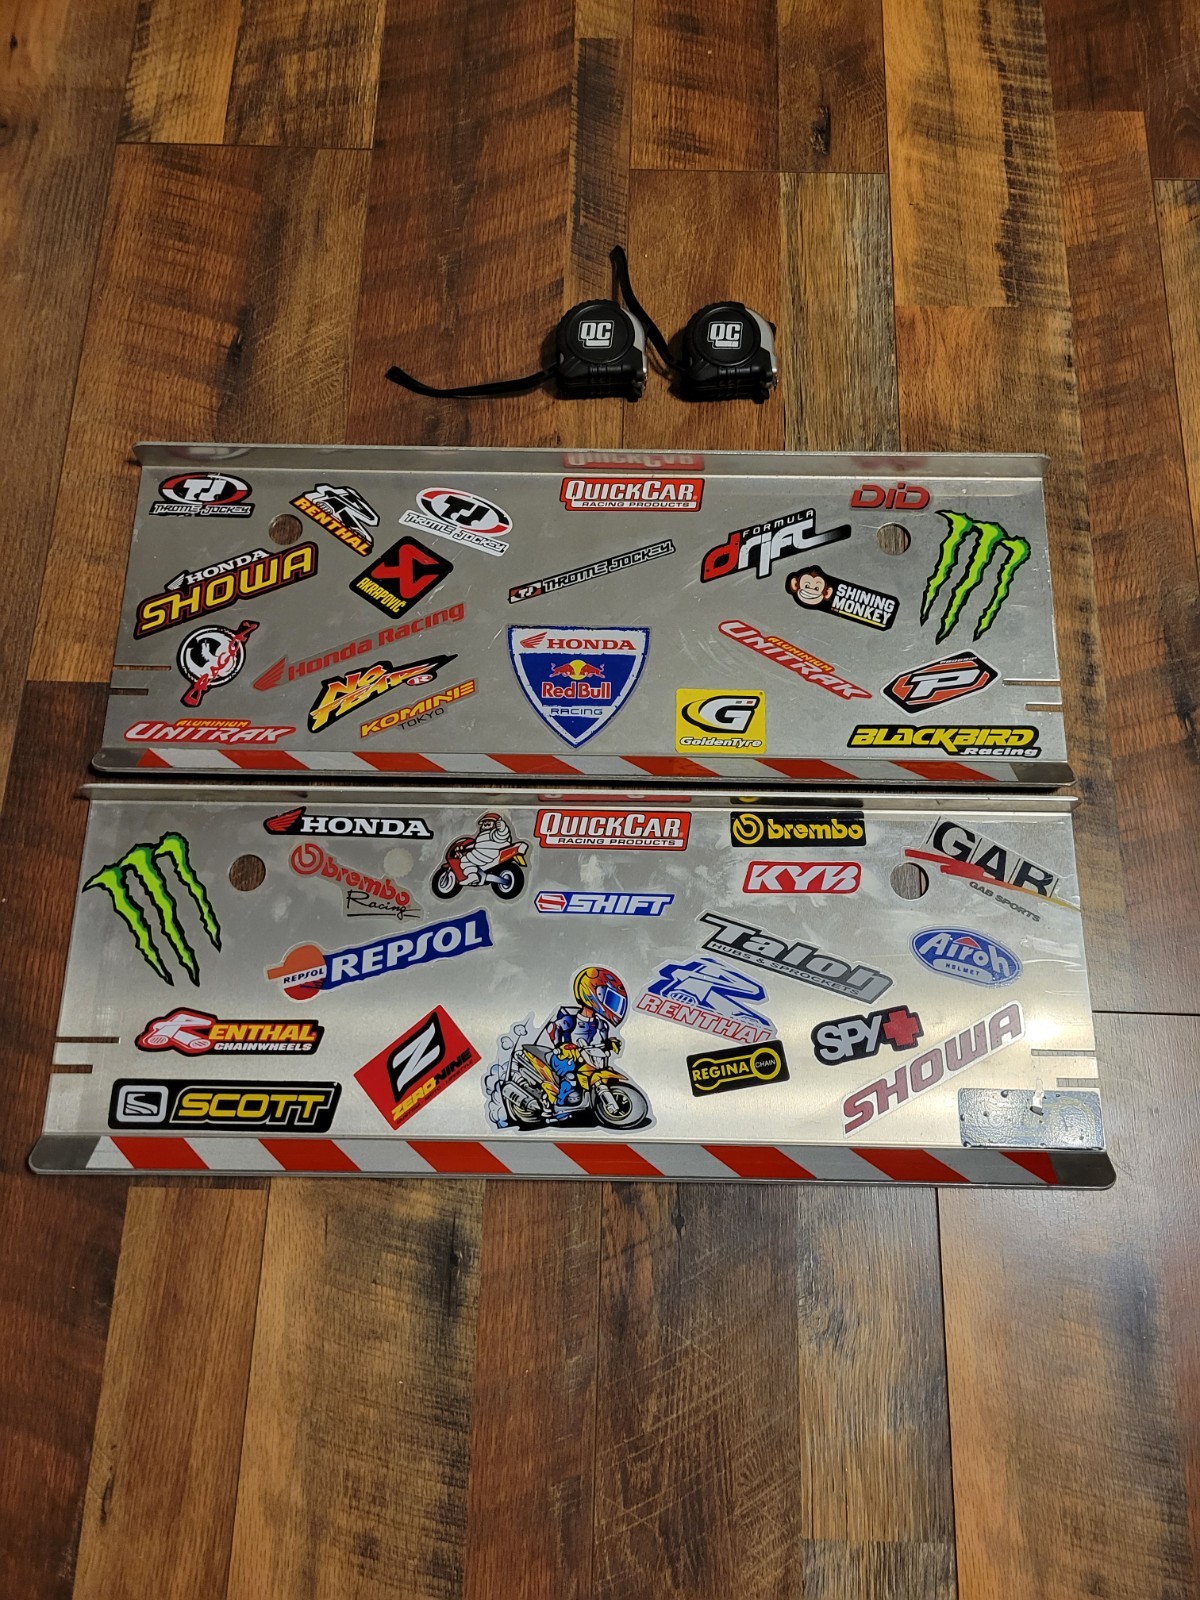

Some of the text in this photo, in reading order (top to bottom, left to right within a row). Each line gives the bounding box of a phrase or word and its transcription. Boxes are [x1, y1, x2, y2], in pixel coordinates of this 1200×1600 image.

[580, 322, 612, 341] QC
[709, 323, 741, 341] QC
[153, 503, 252, 516] THROTTLE JOCKEY
[628, 501, 690, 509] PRODUCTS
[293, 497, 369, 556] RENTHAL
[403, 512, 506, 554] THROTTLE JOCKEY
[742, 509, 815, 539] FORMULA
[703, 518, 851, 582] drift
[186, 549, 270, 585] HONDA
[542, 560, 608, 593] THROTTLE
[608, 540, 675, 572] JOCKEY
[141, 547, 312, 631] SHOWA
[836, 583, 896, 613] SHINING
[832, 595, 892, 625] MONKEY
[288, 638, 373, 681] Honda
[378, 602, 465, 648] Racing
[547, 638, 636, 650] HONDA
[768, 636, 834, 673] ALUMINIUM
[720, 621, 870, 698] UNITRAK
[541, 681, 612, 700] Red Bull
[360, 679, 476, 739] KOMINE
[397, 706, 445, 731] TOKYO
[550, 706, 604, 716] RACING
[125, 723, 294, 742] UNITRAK
[176, 719, 250, 728] ALUMINIUM
[680, 736, 762, 748] GoldenTyre
[850, 727, 1036, 752] BLACKBIRD
[960, 747, 1039, 757] Racing
[301, 816, 432, 837] HONDA
[768, 818, 864, 840] brembo
[558, 837, 676, 846] RACING PRODUCTS
[320, 857, 411, 906] brembo
[747, 864, 860, 891] KYB
[346, 889, 421, 921] Racing
[566, 893, 673, 915] SHIFT
[968, 880, 1041, 923] GAB SPORTS
[330, 920, 483, 983] REPSOL
[700, 912, 894, 1004] Talon
[918, 932, 1012, 978] Airoh
[283, 968, 325, 985] REPSOL
[710, 942, 860, 996] HUBS & SPROCKETS
[945, 962, 980, 977] HELMET
[213, 1042, 312, 1052] CHAINWHEELS
[692, 1059, 776, 1082] REGINA CHAIN
[843, 1003, 1023, 1135] SHOWA
[178, 1092, 326, 1119] SCOTT
